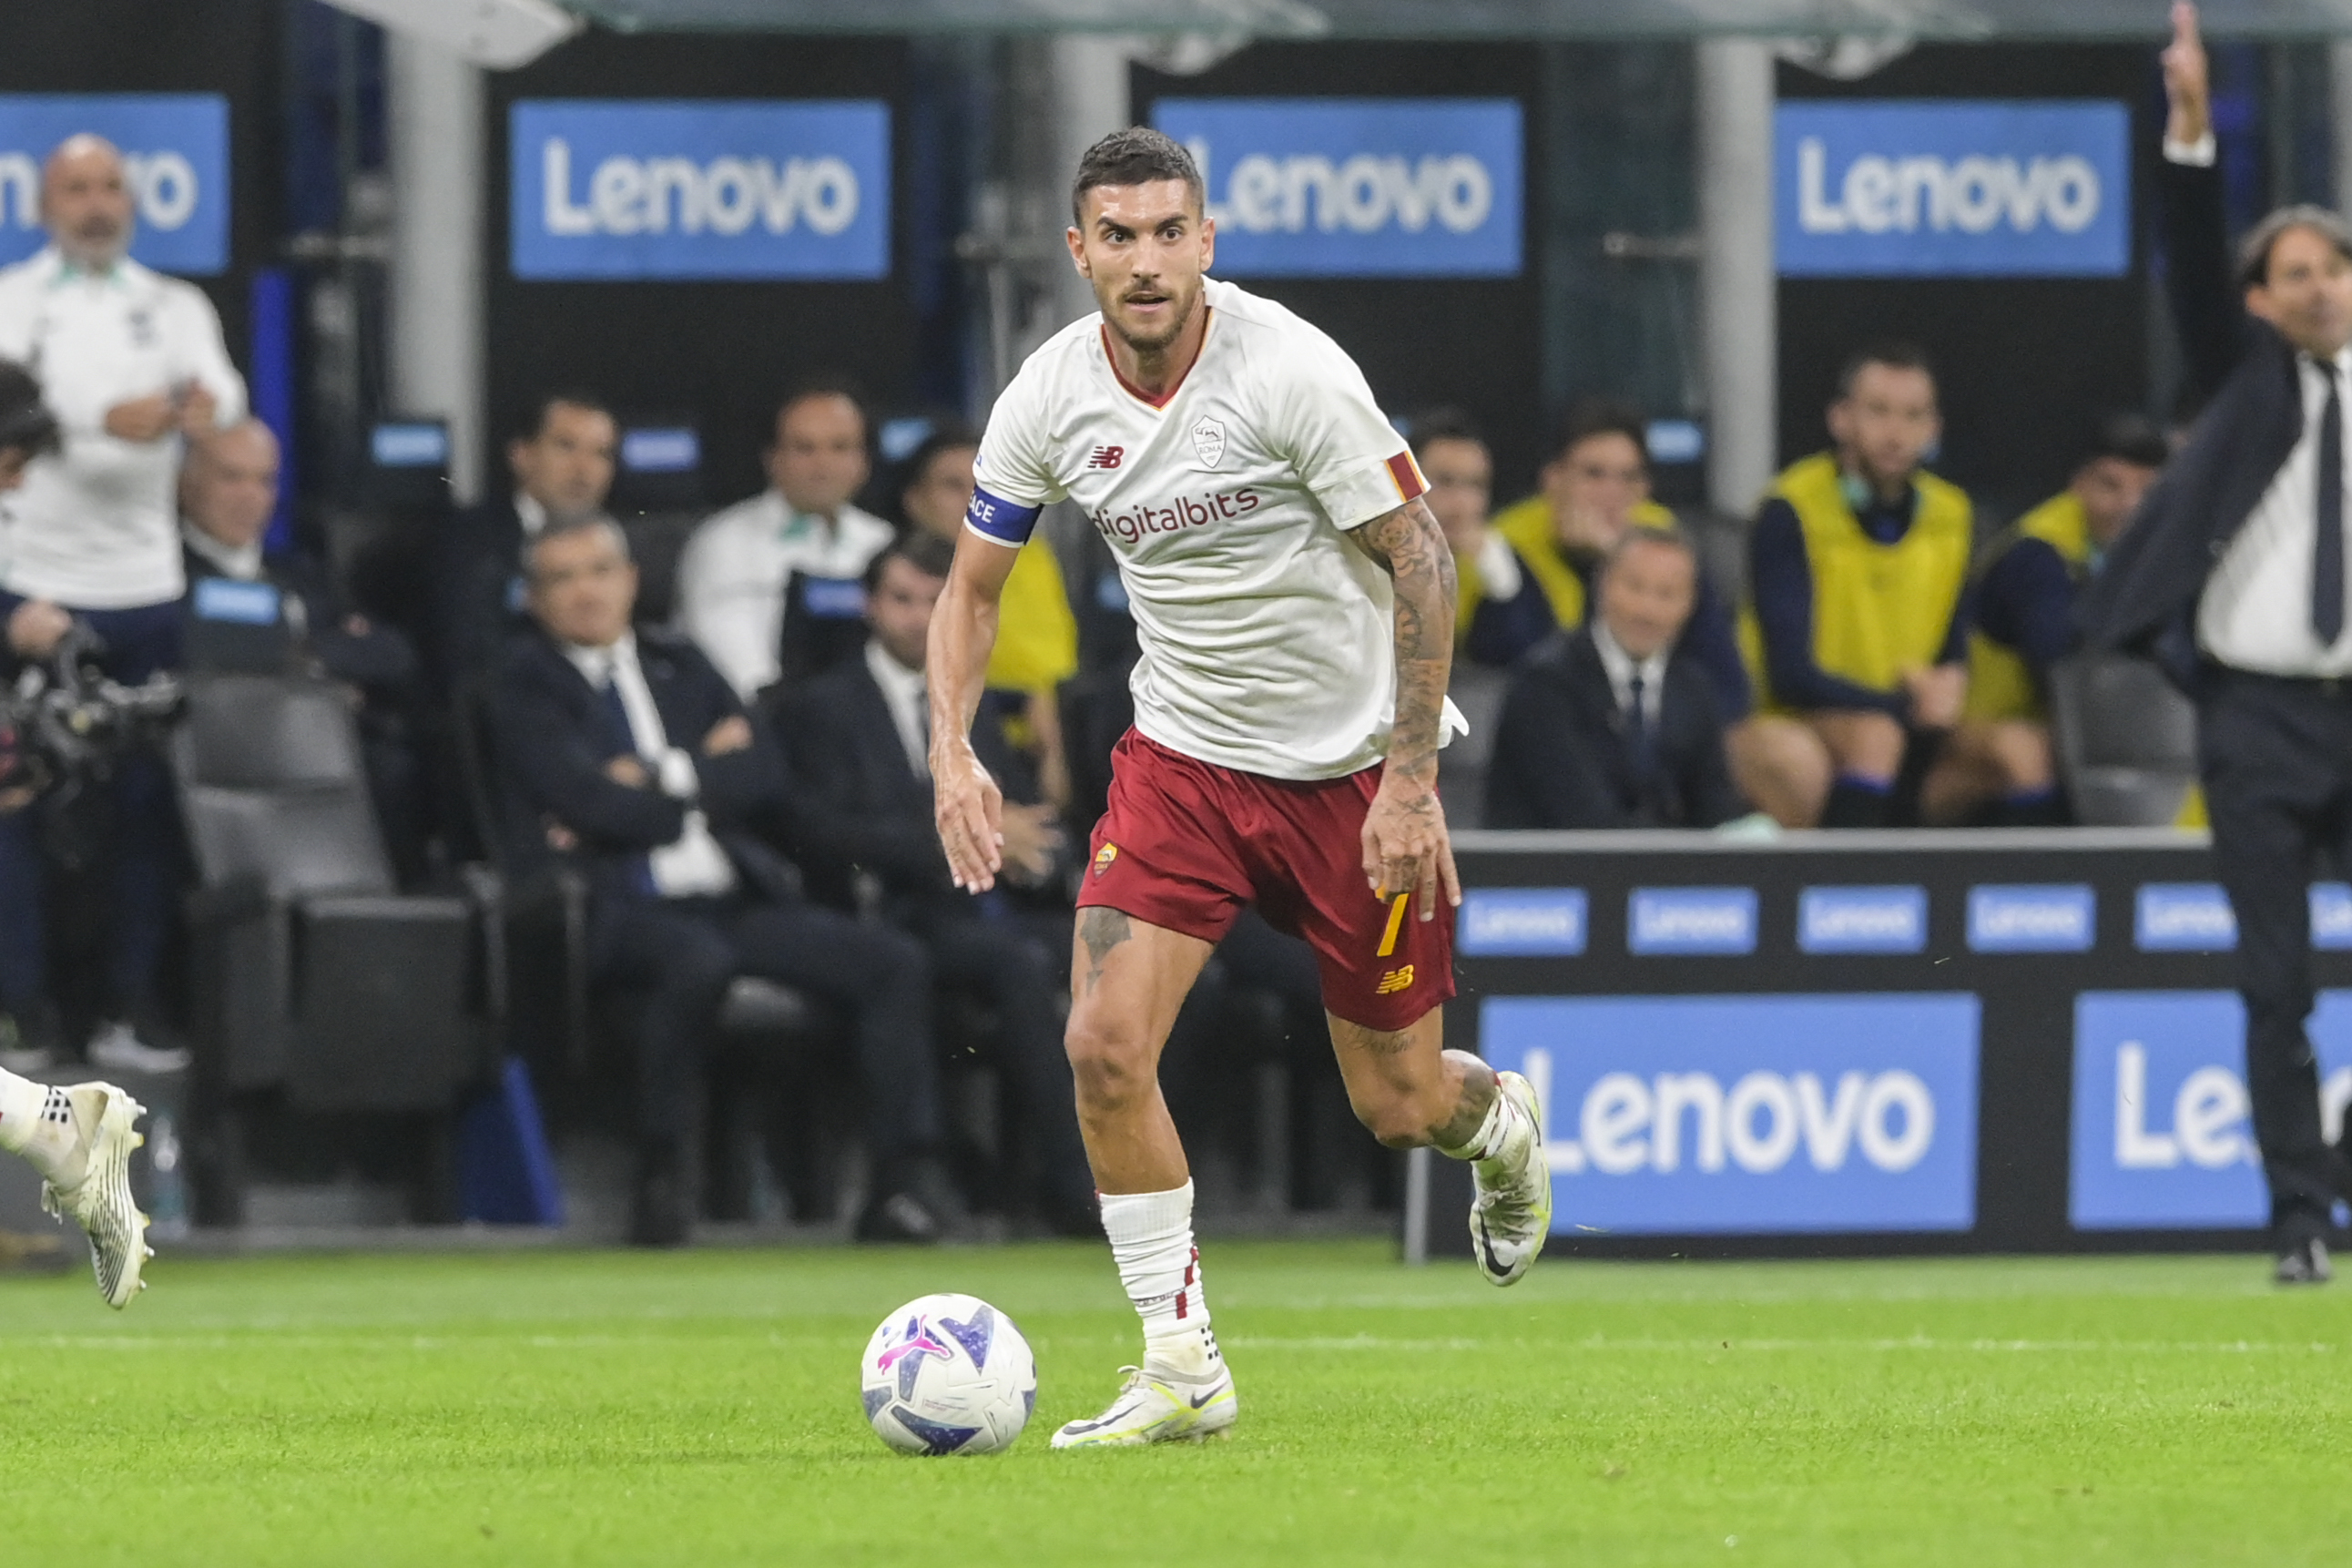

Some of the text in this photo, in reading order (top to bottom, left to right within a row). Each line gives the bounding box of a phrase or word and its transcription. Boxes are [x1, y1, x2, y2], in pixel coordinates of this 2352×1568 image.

[544, 137, 860, 237] Lenovo
[1186, 135, 1492, 235] Lenovo
[1797, 136, 2102, 234] Lenovo
[1092, 488, 1258, 544] digitalbits
[1524, 1047, 1934, 1173] Lenovo
